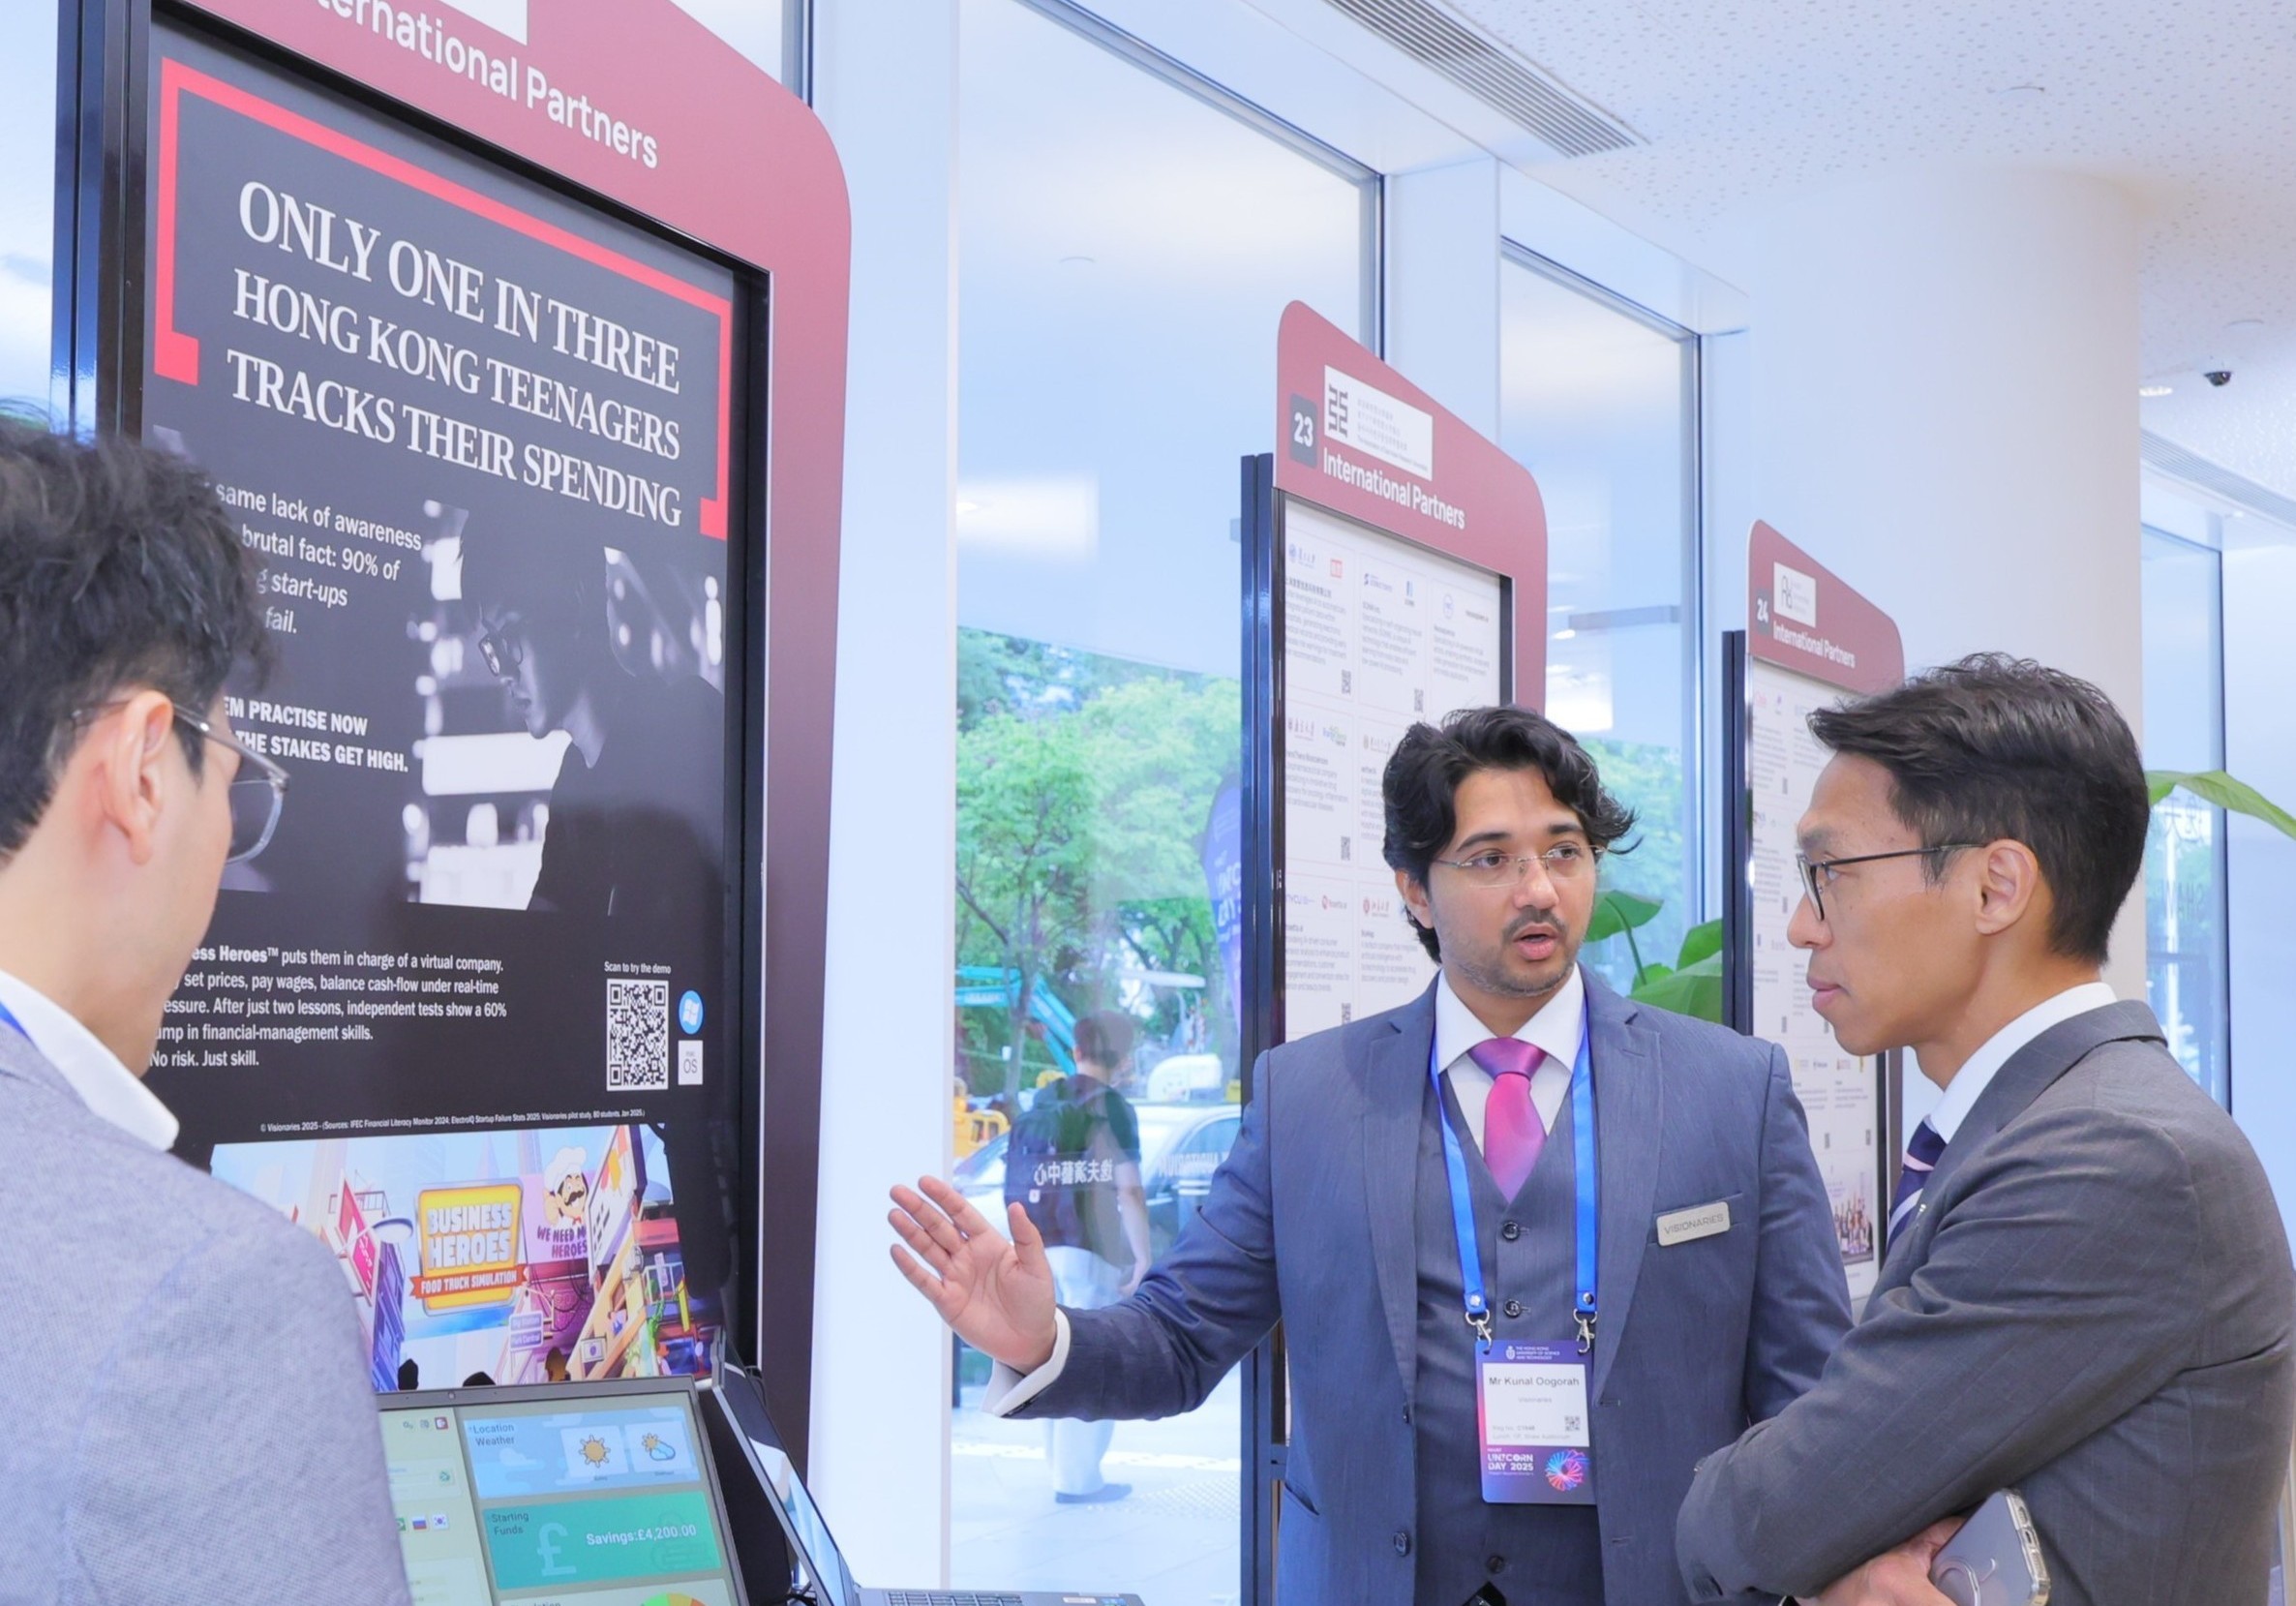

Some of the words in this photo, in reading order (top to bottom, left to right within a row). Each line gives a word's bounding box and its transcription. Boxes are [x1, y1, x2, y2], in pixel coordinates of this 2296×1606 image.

[317, 0, 517, 101] ernational
[527, 66, 658, 168] Partners
[239, 181, 380, 281] ONLY
[389, 239, 484, 324] ONE
[495, 278, 540, 343] IN
[548, 299, 679, 394] THREE
[233, 268, 358, 353] HONG
[368, 316, 480, 394] KONG
[487, 357, 679, 460] TEENAGERS
[227, 348, 395, 443] TRACKS
[403, 405, 516, 482] THEIR
[523, 442, 681, 527] SPENDING
[1293, 411, 1314, 447] 23
[1323, 447, 1410, 508] International
[1413, 486, 1465, 530] Partners
[216, 483, 266, 512] same
[272, 493, 308, 523] lack
[314, 506, 330, 529] of
[335, 514, 422, 551] awareness
[242, 524, 294, 557] brutal
[299, 537, 336, 566] fact:
[342, 548, 378, 576] 90%
[382, 560, 401, 581] of
[271, 573, 347, 608] start-ups
[265, 606, 297, 633] fail.
[1757, 598, 1768, 622] 24
[1773, 621, 1824, 655] International
[1825, 640, 1856, 668] Partners
[224, 696, 244, 717] EM
[249, 700, 327, 731] PRACTISE
[331, 712, 368, 736] NOW
[235, 730, 267, 753] THE
[270, 735, 331, 762] STAKES
[335, 744, 364, 767] GET
[367, 749, 408, 773] HIGH.
[282, 950, 307, 966] puts
[310, 950, 341, 965] them
[344, 951, 354, 965] in
[357, 952, 395, 970] charge
[397, 954, 408, 967] of
[410, 956, 418, 968] a
[420, 955, 453, 969] virtual
[456, 958, 503, 974] company.
[604, 960, 621, 973] Scan
[622, 962, 630, 973] to
[631, 963, 640, 975] try
[641, 963, 651, 974] the
[652, 963, 672, 974] demo
[184, 972, 204, 986] set
[207, 973, 248, 990] prices,
[252, 976, 273, 991] pay
[276, 977, 317, 993] wages,
[320, 975, 365, 990] balance
[368, 977, 418, 992] cash-flow
[421, 978, 451, 992] under
[454, 979, 499, 994] real-time
[164, 999, 209, 1014] essure.
[213, 997, 244, 1014] After
[246, 998, 270, 1017] just
[273, 1000, 294, 1015] two
[298, 999, 344, 1016] lessons,
[347, 1000, 415, 1018] independent
[418, 1002, 443, 1016] tests
[446, 1002, 472, 1016] show
[474, 1006, 482, 1016] a
[484, 1002, 507, 1016] 60%
[187, 1024, 198, 1040] in
[202, 1023, 339, 1044] financial-management
[341, 1024, 374, 1040] skills.
[150, 1050, 167, 1067] No
[171, 1050, 198, 1066] risk.
[201, 1049, 227, 1066] Just
[230, 1050, 259, 1066] skill.
[267, 1122, 300, 1133] Visionaries
[301, 1121, 318, 1131] 2025
[349, 1119, 363, 1129] IFEC
[364, 1118, 389, 1128] Financial
[390, 1118, 411, 1128] Literacy
[412, 1117, 434, 1126] Monitor
[475, 1115, 494, 1125] Startup
[495, 1114, 512, 1123] Failure
[512, 1113, 526, 1122] Stats
[542, 1111, 567, 1121] Visionaries
[567, 1111, 578, 1121] pilot
[428, 1203, 512, 1234] BUSINESS
[1665, 1213, 1724, 1234] VISIONARIES
[537, 1226, 551, 1241] WE
[553, 1227, 575, 1241] NEED
[428, 1233, 511, 1269] HEROES
[551, 1239, 588, 1258] HEROES
[421, 1280, 442, 1294] FOOD
[443, 1276, 469, 1291] TRUCK
[471, 1270, 518, 1287] SIMULATION
[472, 1423, 514, 1435] Location
[475, 1436, 515, 1446] Weather
[1488, 1462, 1506, 1470] DAY
[1510, 1462, 1533, 1470] 2025
[492, 1512, 529, 1524] Starting
[494, 1526, 524, 1535] Funds
